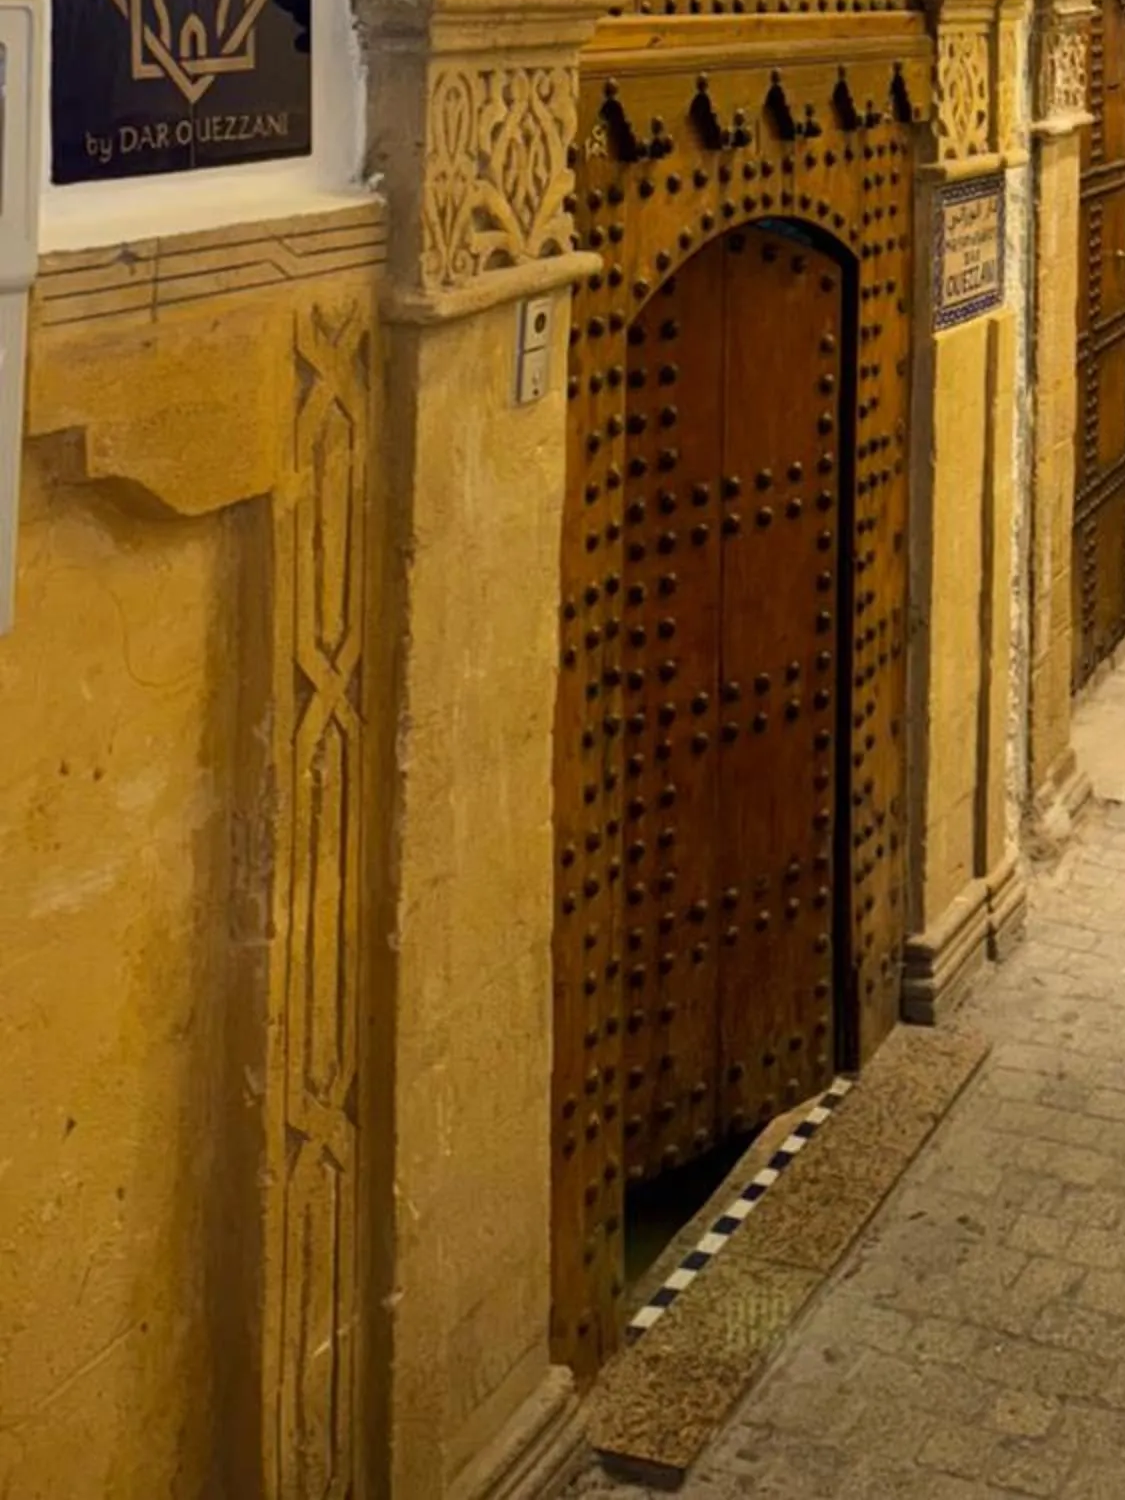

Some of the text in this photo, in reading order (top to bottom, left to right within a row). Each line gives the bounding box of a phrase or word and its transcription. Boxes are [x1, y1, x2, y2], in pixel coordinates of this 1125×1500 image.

[85, 112, 289, 163] by DAR OUEZZANI
